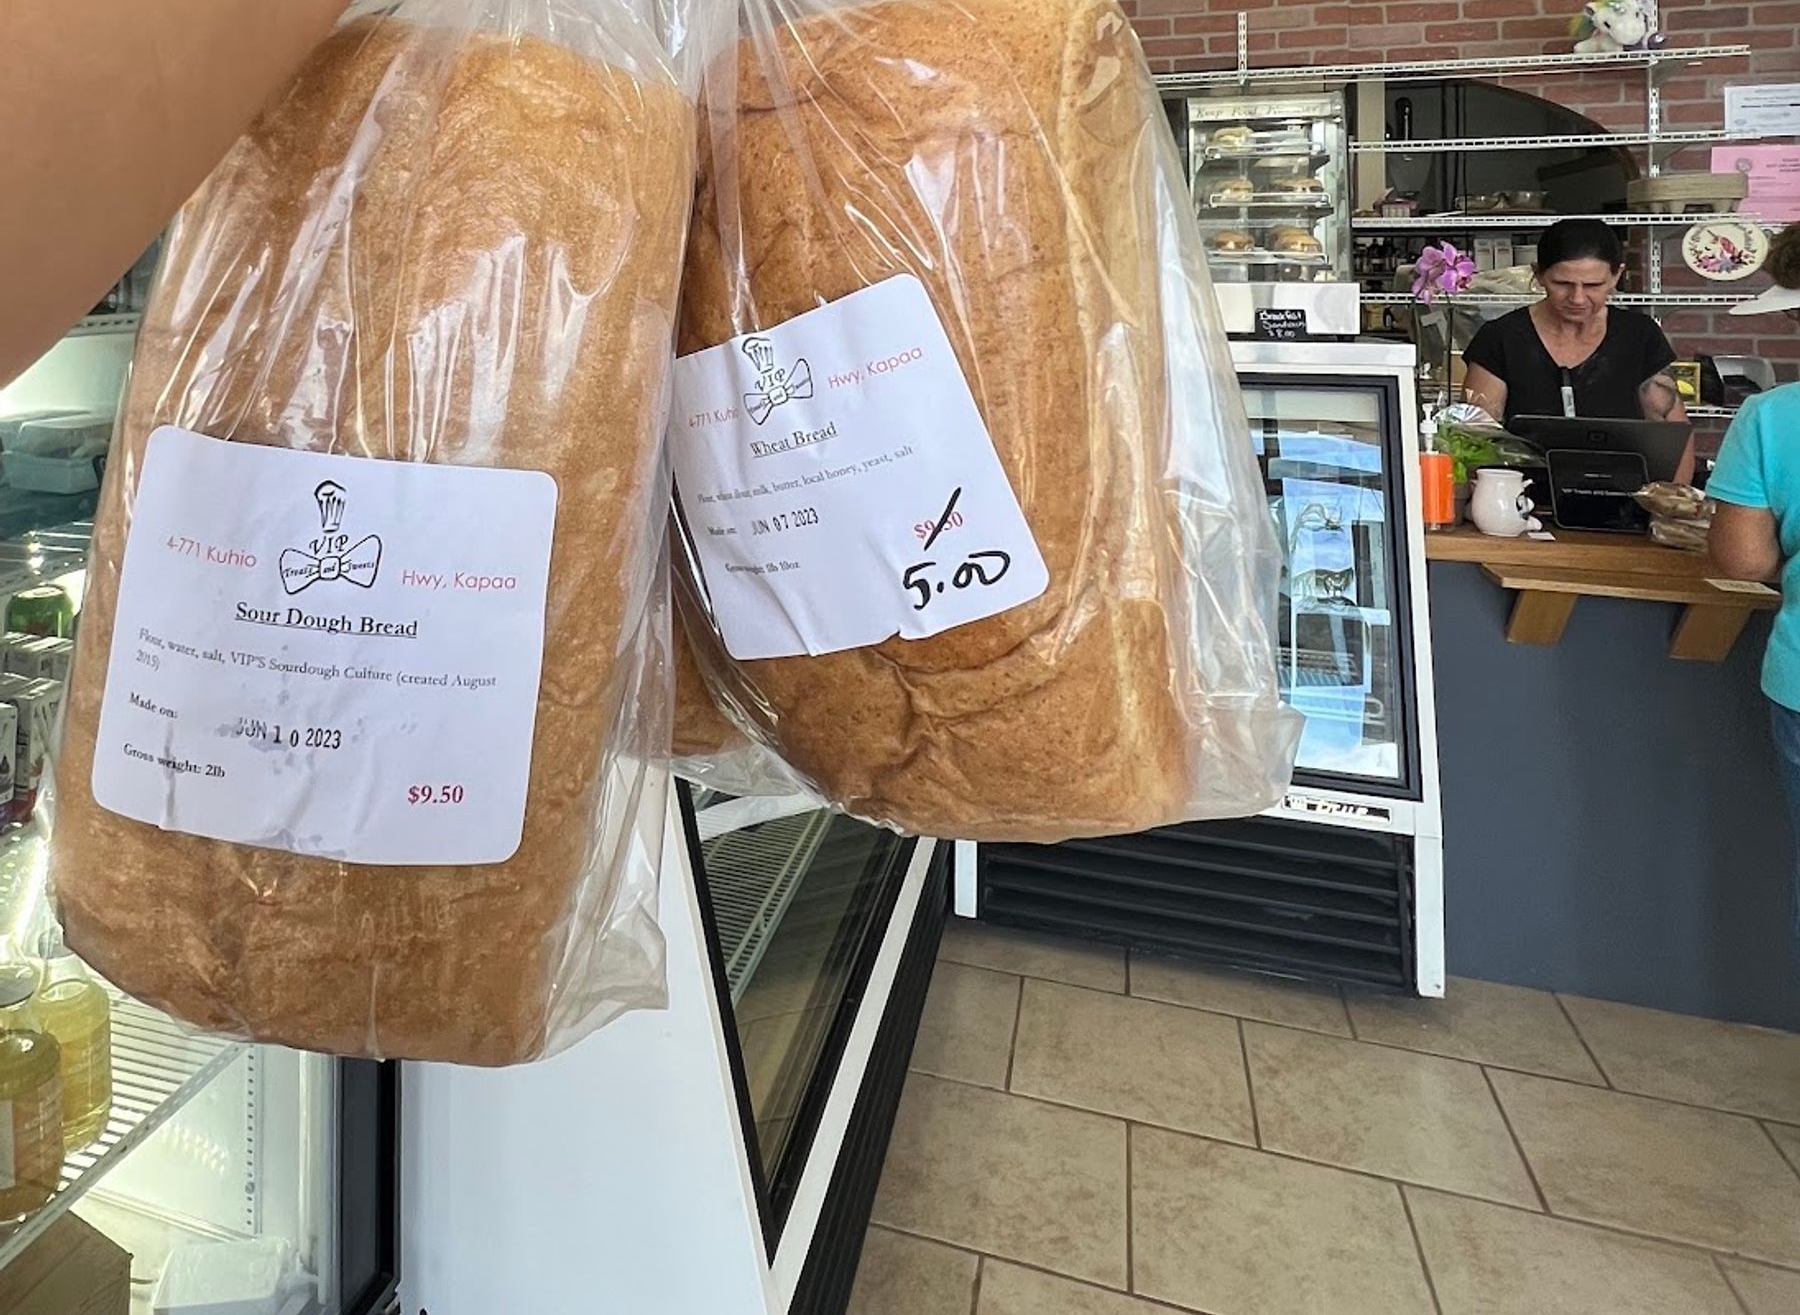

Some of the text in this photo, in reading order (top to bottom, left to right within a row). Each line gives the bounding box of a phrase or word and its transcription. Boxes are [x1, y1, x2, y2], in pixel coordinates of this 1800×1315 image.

[867, 347, 922, 376] Kapaa
[754, 368, 786, 392] VIP
[750, 421, 838, 457] Wheat Bread
[801, 471, 824, 485] local
[894, 445, 913, 459] salt
[752, 507, 819, 535] JUN 07 2023
[914, 511, 963, 539] $950
[309, 534, 349, 555] VIP
[206, 546, 257, 568] Kuhio
[402, 569, 447, 590] Hwy,
[454, 571, 516, 592] Kapaa
[903, 550, 1011, 610] 5.00
[235, 602, 418, 637] Sour Dough Bread
[268, 658, 340, 682] Sourdough
[343, 665, 393, 683] Culture
[396, 670, 448, 687] (created
[451, 673, 497, 690] August
[129, 692, 157, 713] Made
[236, 716, 267, 740] JUN
[305, 727, 341, 750] 2023
[123, 742, 226, 779] Gross weight: 2lb
[407, 784, 464, 805] $9.50
